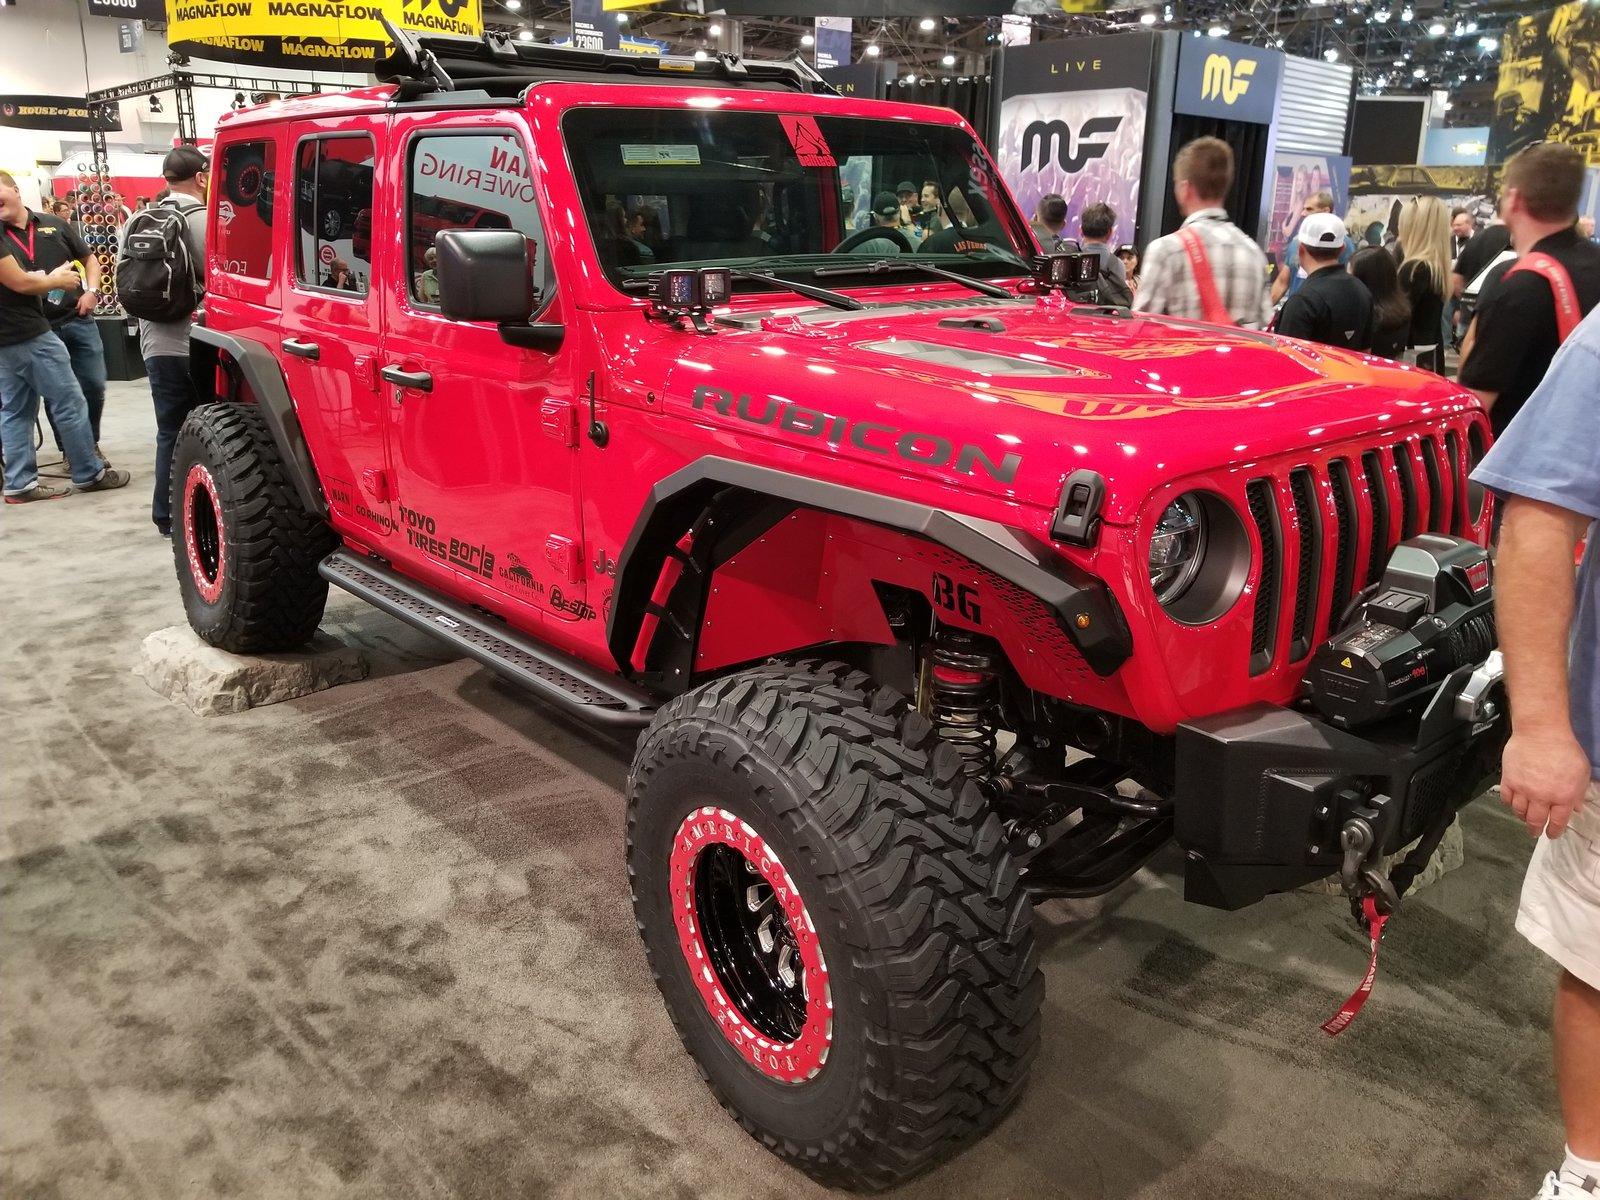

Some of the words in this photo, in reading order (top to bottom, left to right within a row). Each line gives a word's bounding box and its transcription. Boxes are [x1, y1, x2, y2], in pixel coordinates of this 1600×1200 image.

[176, 3, 252, 21] MAGNAFLOW
[268, 3, 382, 21] MAGNAFLOW
[403, 11, 474, 36] MAGNAFLOW
[190, 36, 265, 52] AGNAFLOW
[282, 42, 375, 59] MAGNAFLOW
[1051, 60, 1102, 74] LIVE
[18, 105, 58, 116] HOUSE
[692, 384, 1023, 485] RUBICON
[399, 505, 436, 535] TOYO
[407, 528, 447, 560] TIRES
[499, 566, 545, 594] CALIFORNIA
